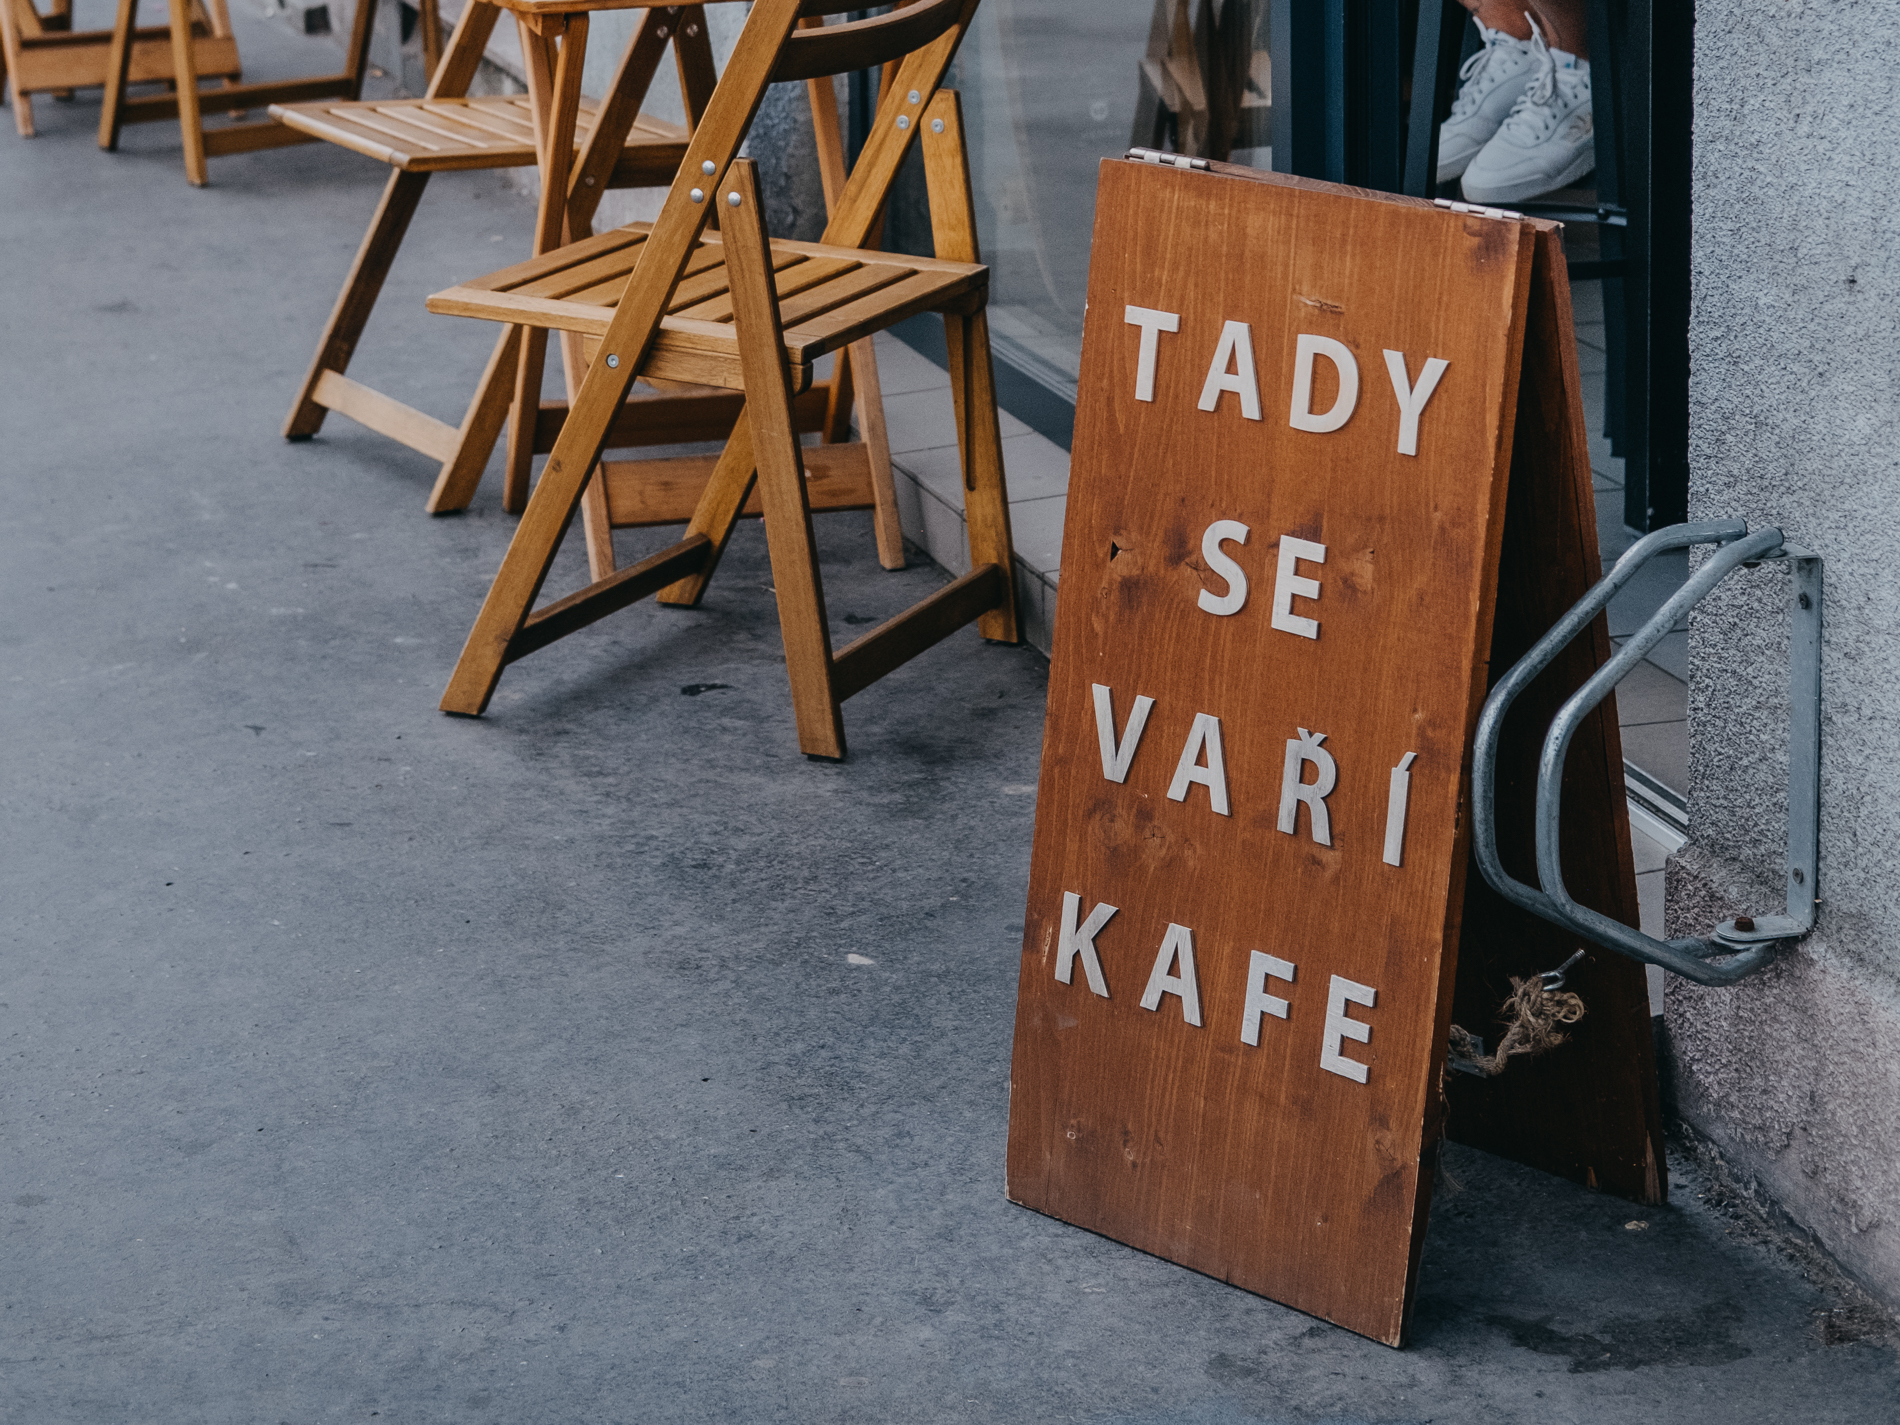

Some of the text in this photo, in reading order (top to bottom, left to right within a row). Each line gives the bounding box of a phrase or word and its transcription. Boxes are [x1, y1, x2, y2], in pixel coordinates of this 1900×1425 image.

[1123, 304, 1450, 457] TADY
[1197, 519, 1328, 641] SE
[1091, 682, 1417, 867] VAŘÍ
[1054, 890, 1377, 1085] KAFE
